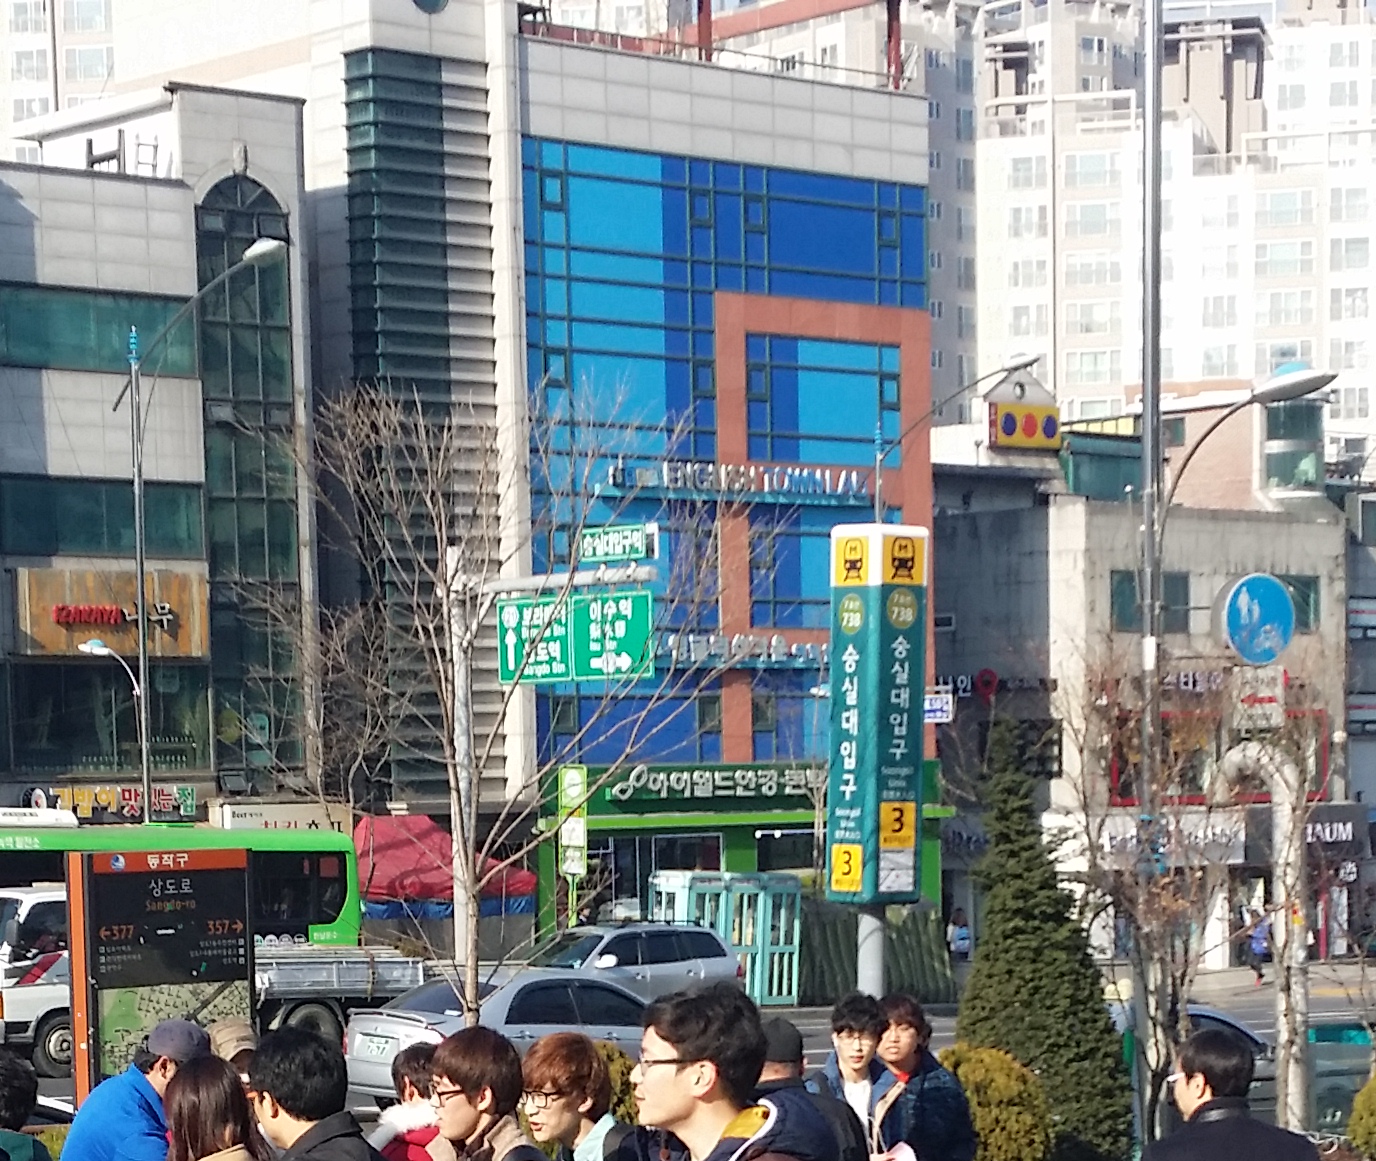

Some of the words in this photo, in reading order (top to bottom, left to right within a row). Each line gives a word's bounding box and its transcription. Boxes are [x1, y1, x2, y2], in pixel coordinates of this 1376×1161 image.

[582, 528, 643, 557] 숭실대입구역
[589, 597, 633, 621] 이수역
[842, 612, 861, 628] 738
[891, 606, 914, 622] 738
[888, 634, 912, 761] 숭실대입구
[839, 643, 861, 801] 숭실대입구
[891, 807, 904, 834] 3
[147, 852, 190, 869] 동작구
[842, 850, 853, 876] 3
[148, 877, 194, 898] 상도로
[111, 924, 135, 940] 377
[207, 919, 230, 935] 357
